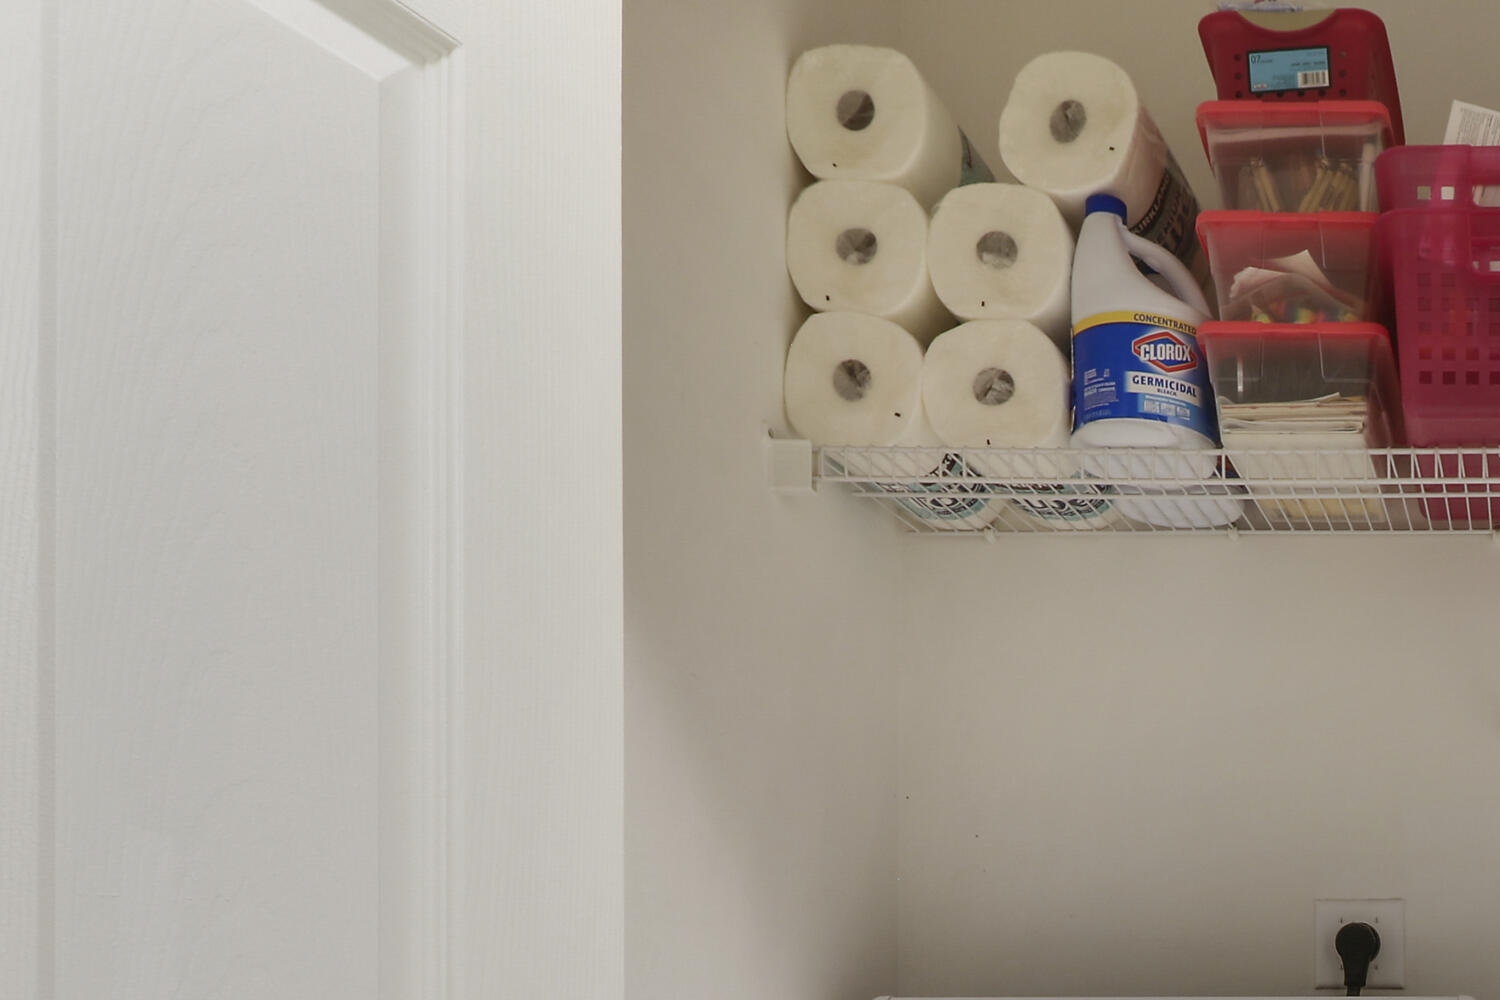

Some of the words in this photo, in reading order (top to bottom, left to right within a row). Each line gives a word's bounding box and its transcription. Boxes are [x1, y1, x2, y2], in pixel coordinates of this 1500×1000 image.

[1133, 312, 1197, 336] CONCENTRATED
[1139, 343, 1193, 362] CLOROX
[1132, 374, 1198, 398] GERMICIDAL
[1156, 387, 1178, 397] BLEACH
